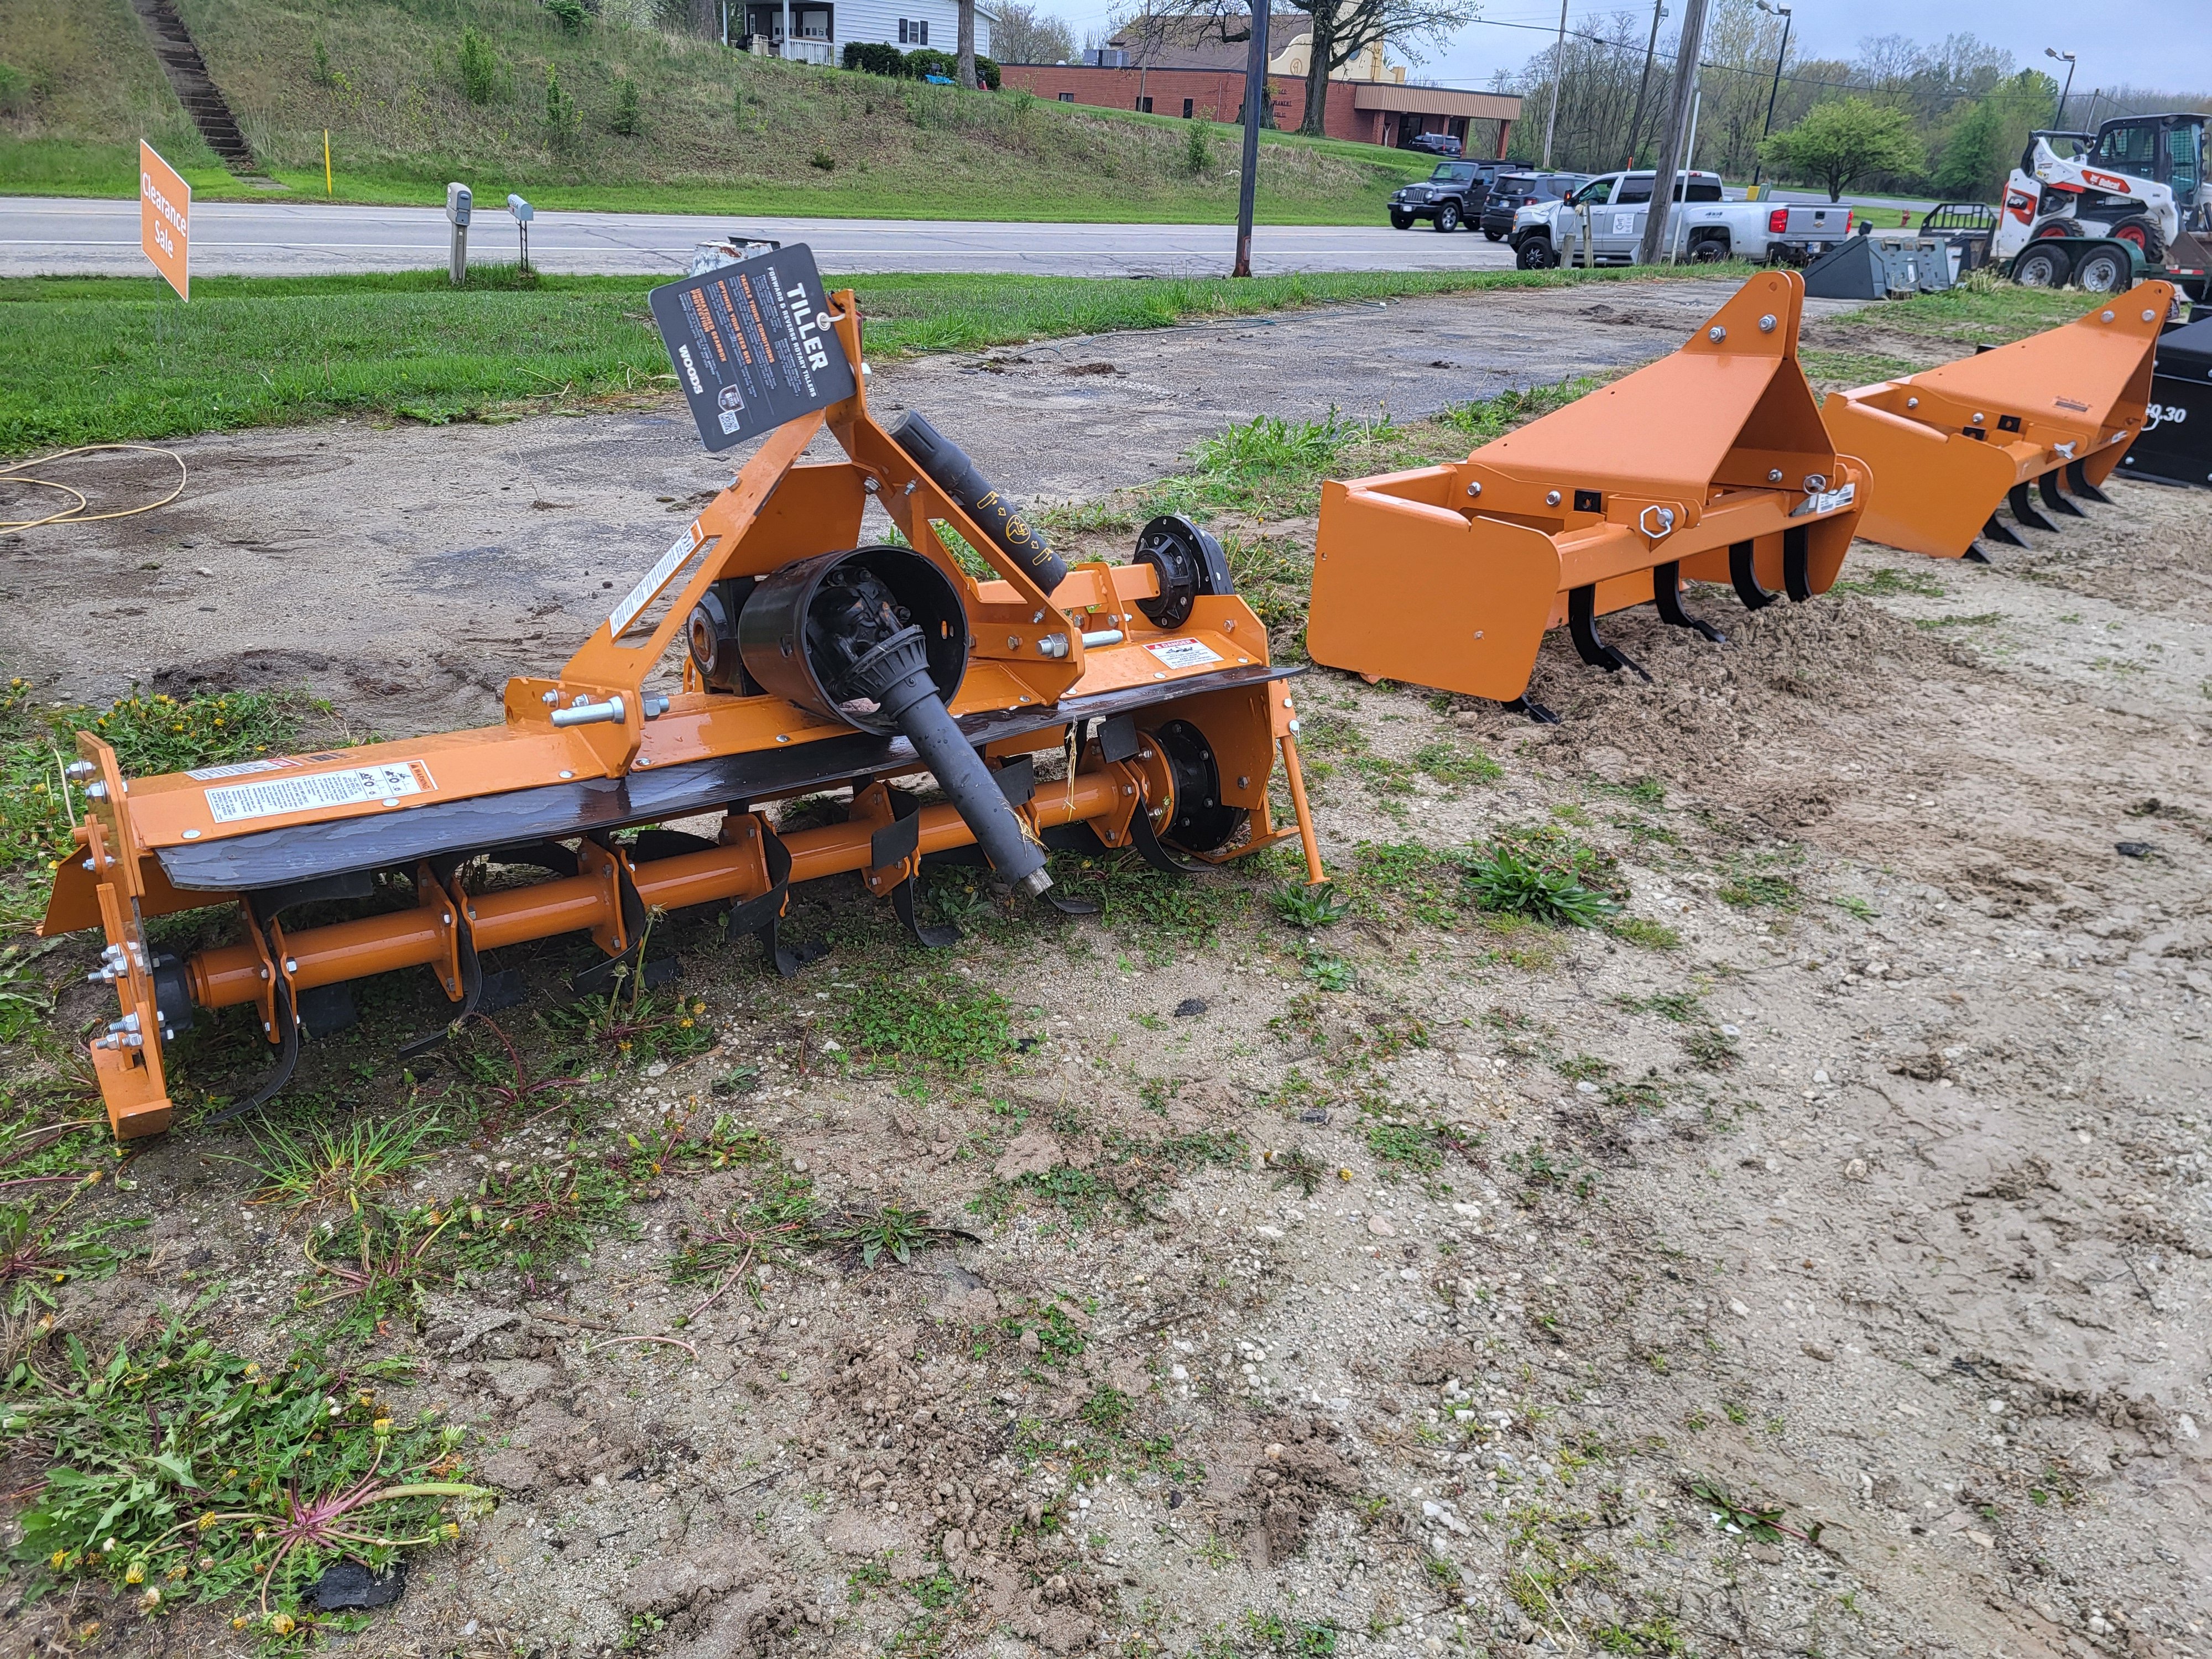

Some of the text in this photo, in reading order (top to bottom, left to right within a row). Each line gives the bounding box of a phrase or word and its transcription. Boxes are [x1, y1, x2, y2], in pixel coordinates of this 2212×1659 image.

[143, 172, 186, 237] Clearance
[2099, 178, 2121, 190] Bobcat
[155, 220, 174, 258] Sale
[717, 280, 733, 312] OPTIMIZE
[730, 314, 740, 331] YOUR
[787, 283, 828, 371] TILLER
[711, 331, 727, 362] GEARBOX
[749, 300, 760, 322] TOUGH
[757, 324, 775, 363] CONDITIONS
[767, 267, 784, 301] FORWARD
[782, 310, 797, 341] REVERSE
[793, 342, 806, 368] ROTARY
[802, 370, 816, 397] TILLERS
[679, 345, 703, 394] WOODS
[414, 769, 430, 789] WARNING
